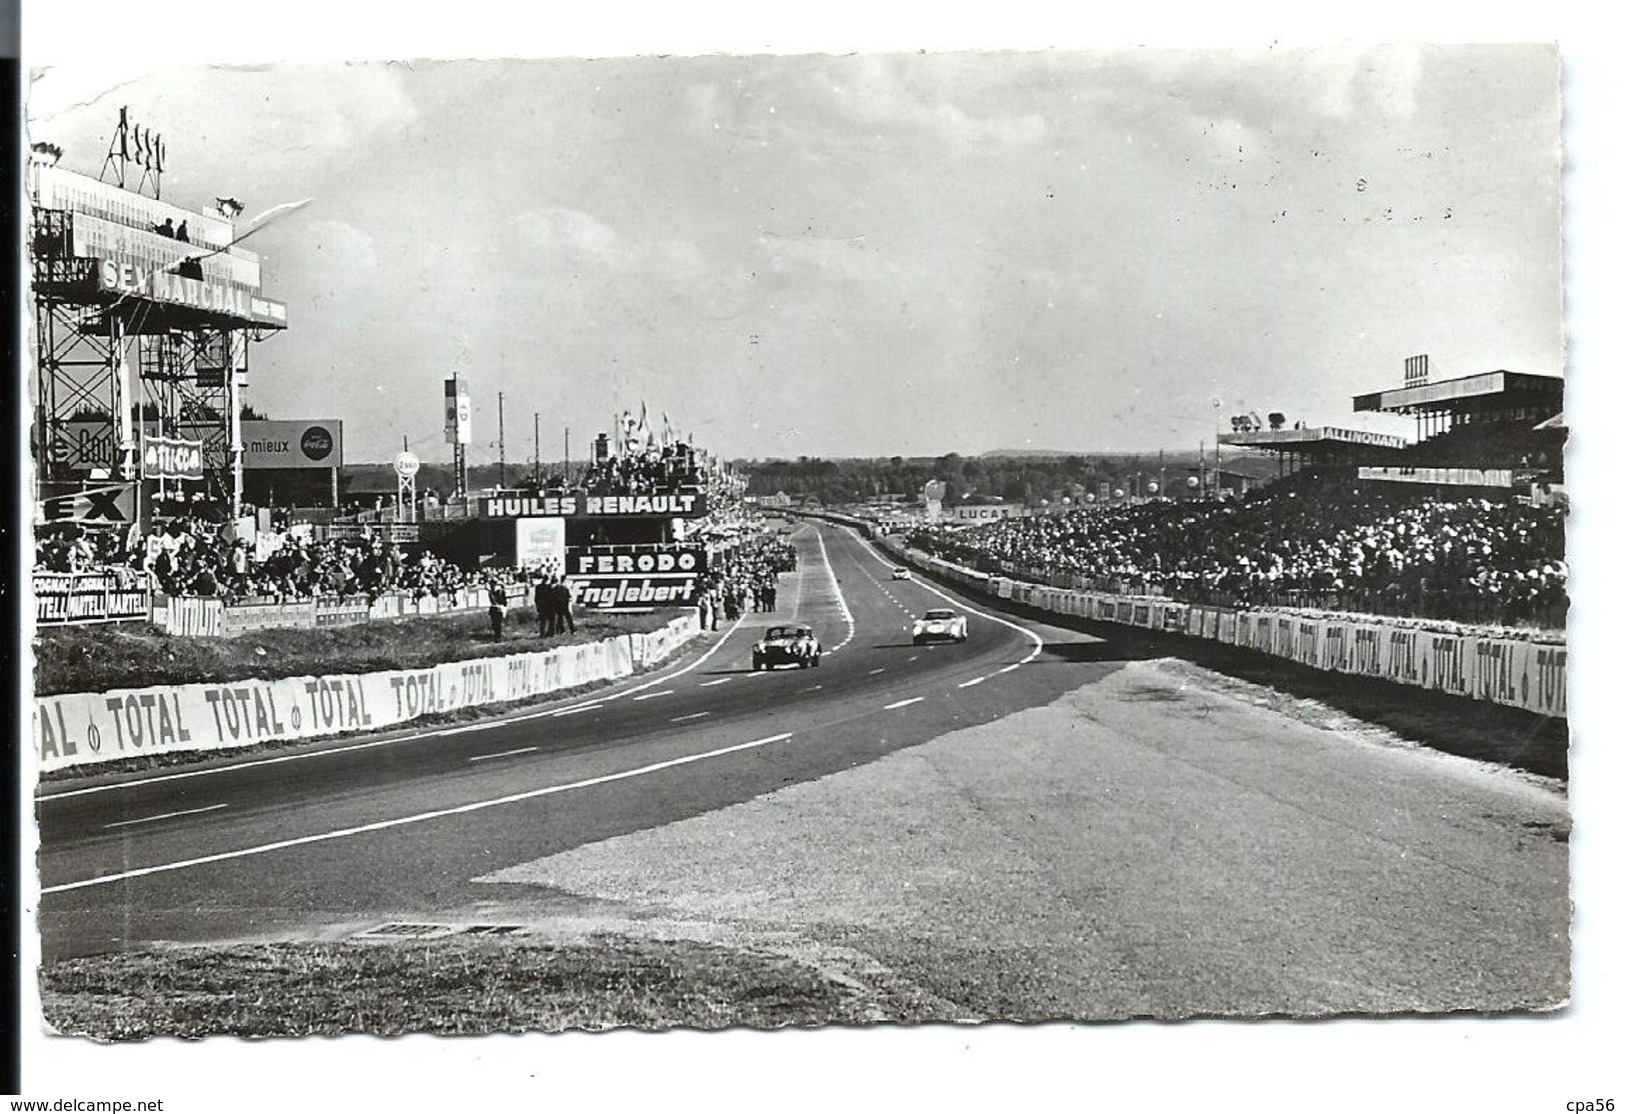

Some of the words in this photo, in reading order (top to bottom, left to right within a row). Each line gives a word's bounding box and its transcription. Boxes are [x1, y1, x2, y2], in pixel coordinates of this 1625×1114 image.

[251, 438, 289, 453] mieux
[488, 497, 576, 516] HUILES
[587, 495, 696, 514] RENAULT
[959, 508, 1009, 519] LUCAS
[579, 555, 696, 573] FERODO
[569, 579, 695, 606] Englebert
[108, 593, 147, 614] MARTELL
[1432, 637, 1466, 692] TOTAL
[1476, 641, 1516, 700] TOTAL
[106, 693, 191, 750] TOTAL
[205, 686, 285, 741] TOTAL
[306, 680, 372, 729] TOTAL
[391, 671, 444, 718] TOTAL
[462, 664, 495, 701] TOTAL
